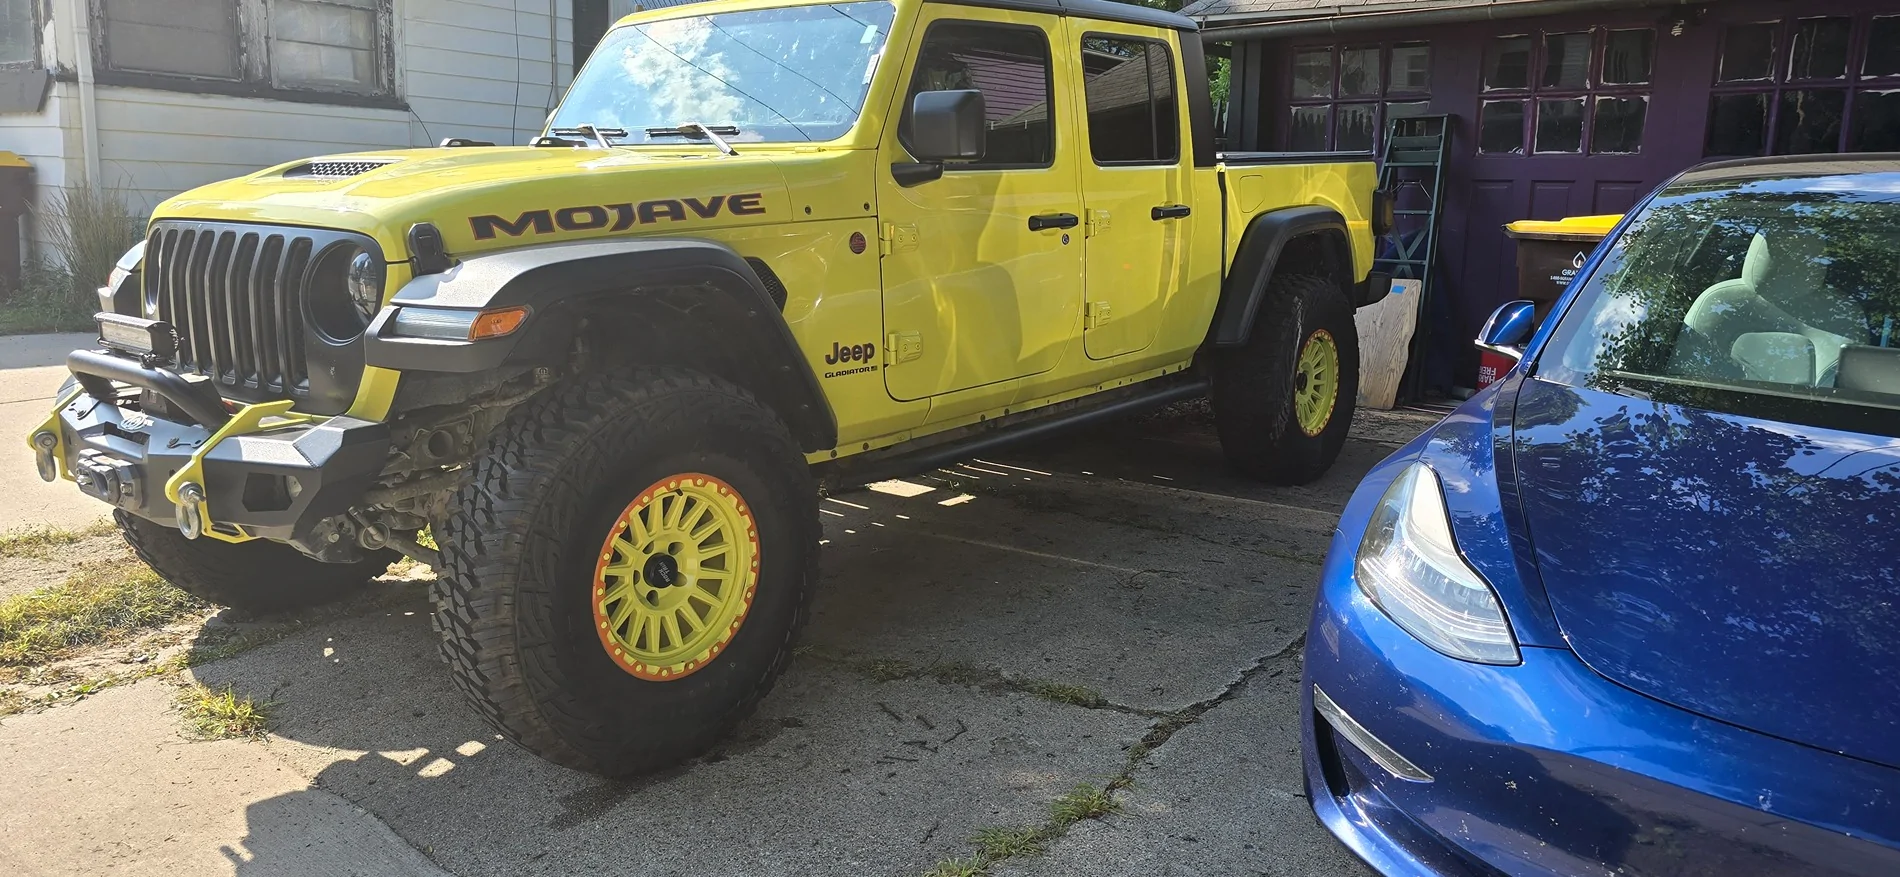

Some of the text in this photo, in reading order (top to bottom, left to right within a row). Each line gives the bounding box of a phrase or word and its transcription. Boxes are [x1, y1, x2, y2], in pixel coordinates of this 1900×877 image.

[468, 192, 766, 240] MOJAVE
[825, 342, 875, 365] Jeep
[824, 366, 870, 378] GLADIATOR
